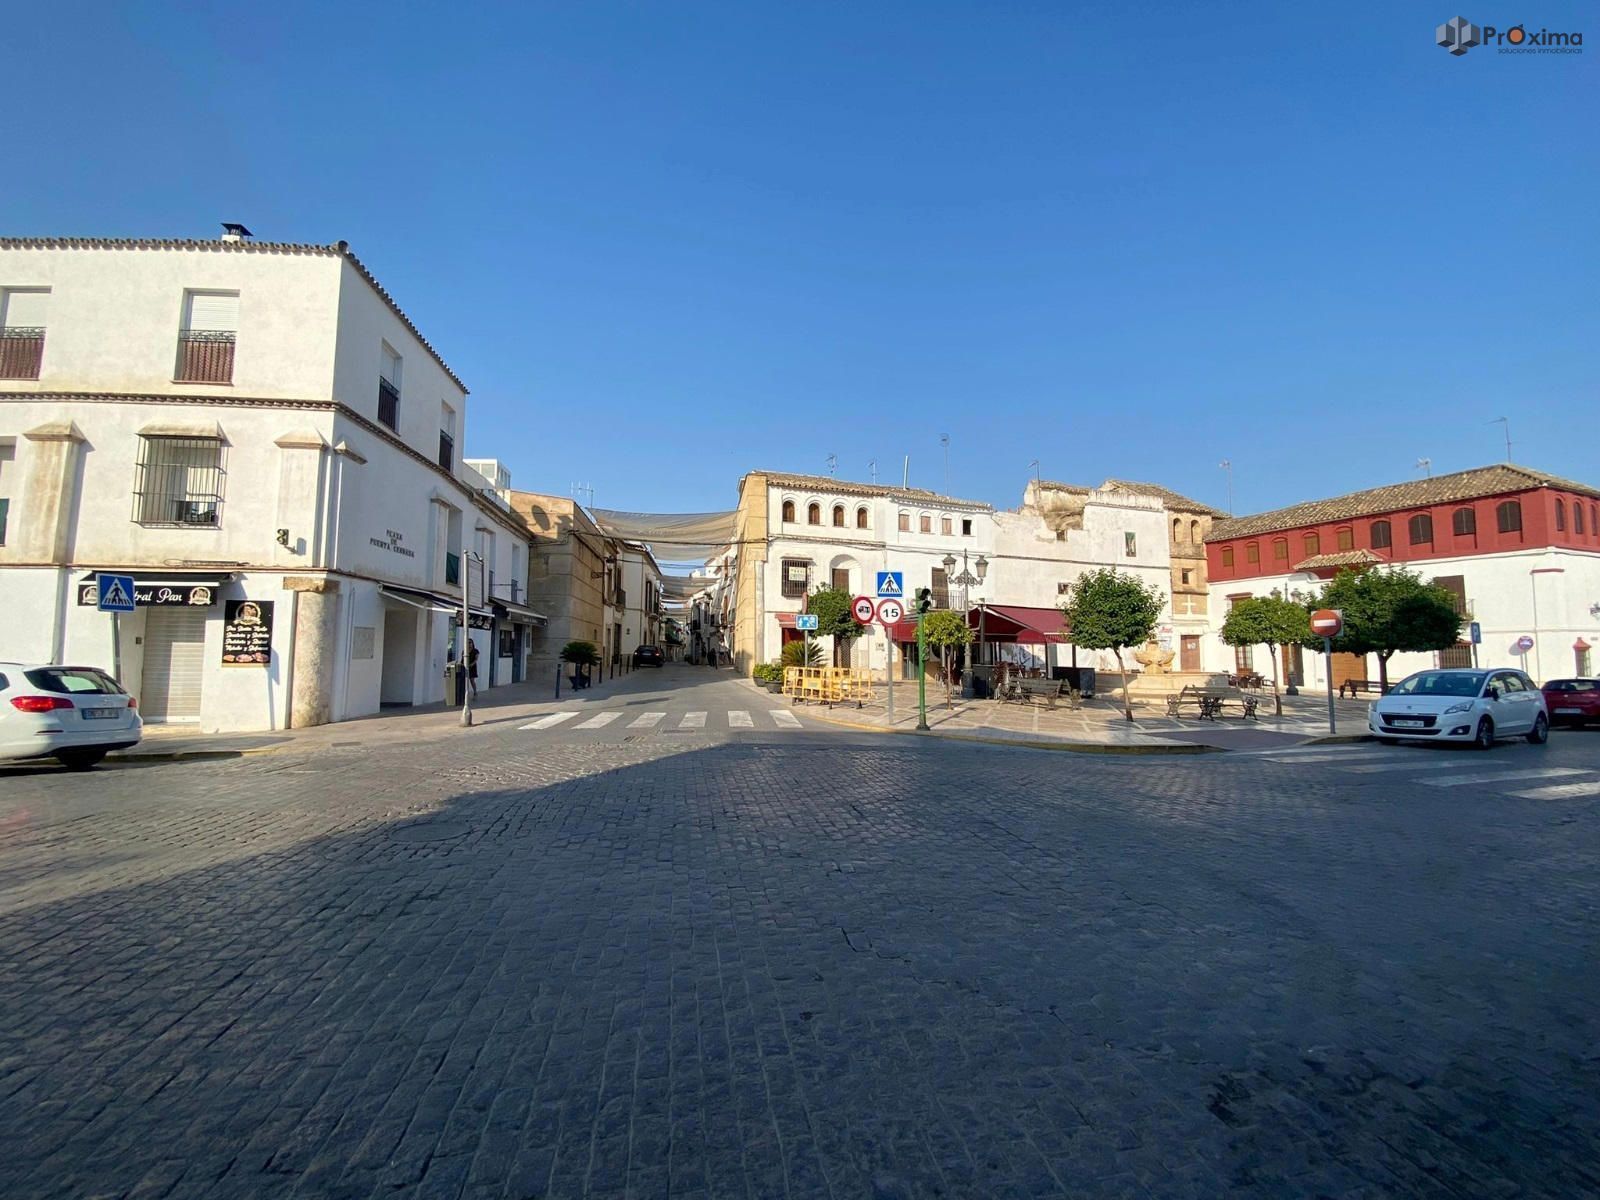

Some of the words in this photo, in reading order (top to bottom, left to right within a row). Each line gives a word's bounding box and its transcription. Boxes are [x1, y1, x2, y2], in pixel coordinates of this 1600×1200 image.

[369, 537, 391, 551] PUERTA
[134, 590, 153, 601] tral
[156, 587, 183, 603] Pan
[883, 608, 899, 618] 15
